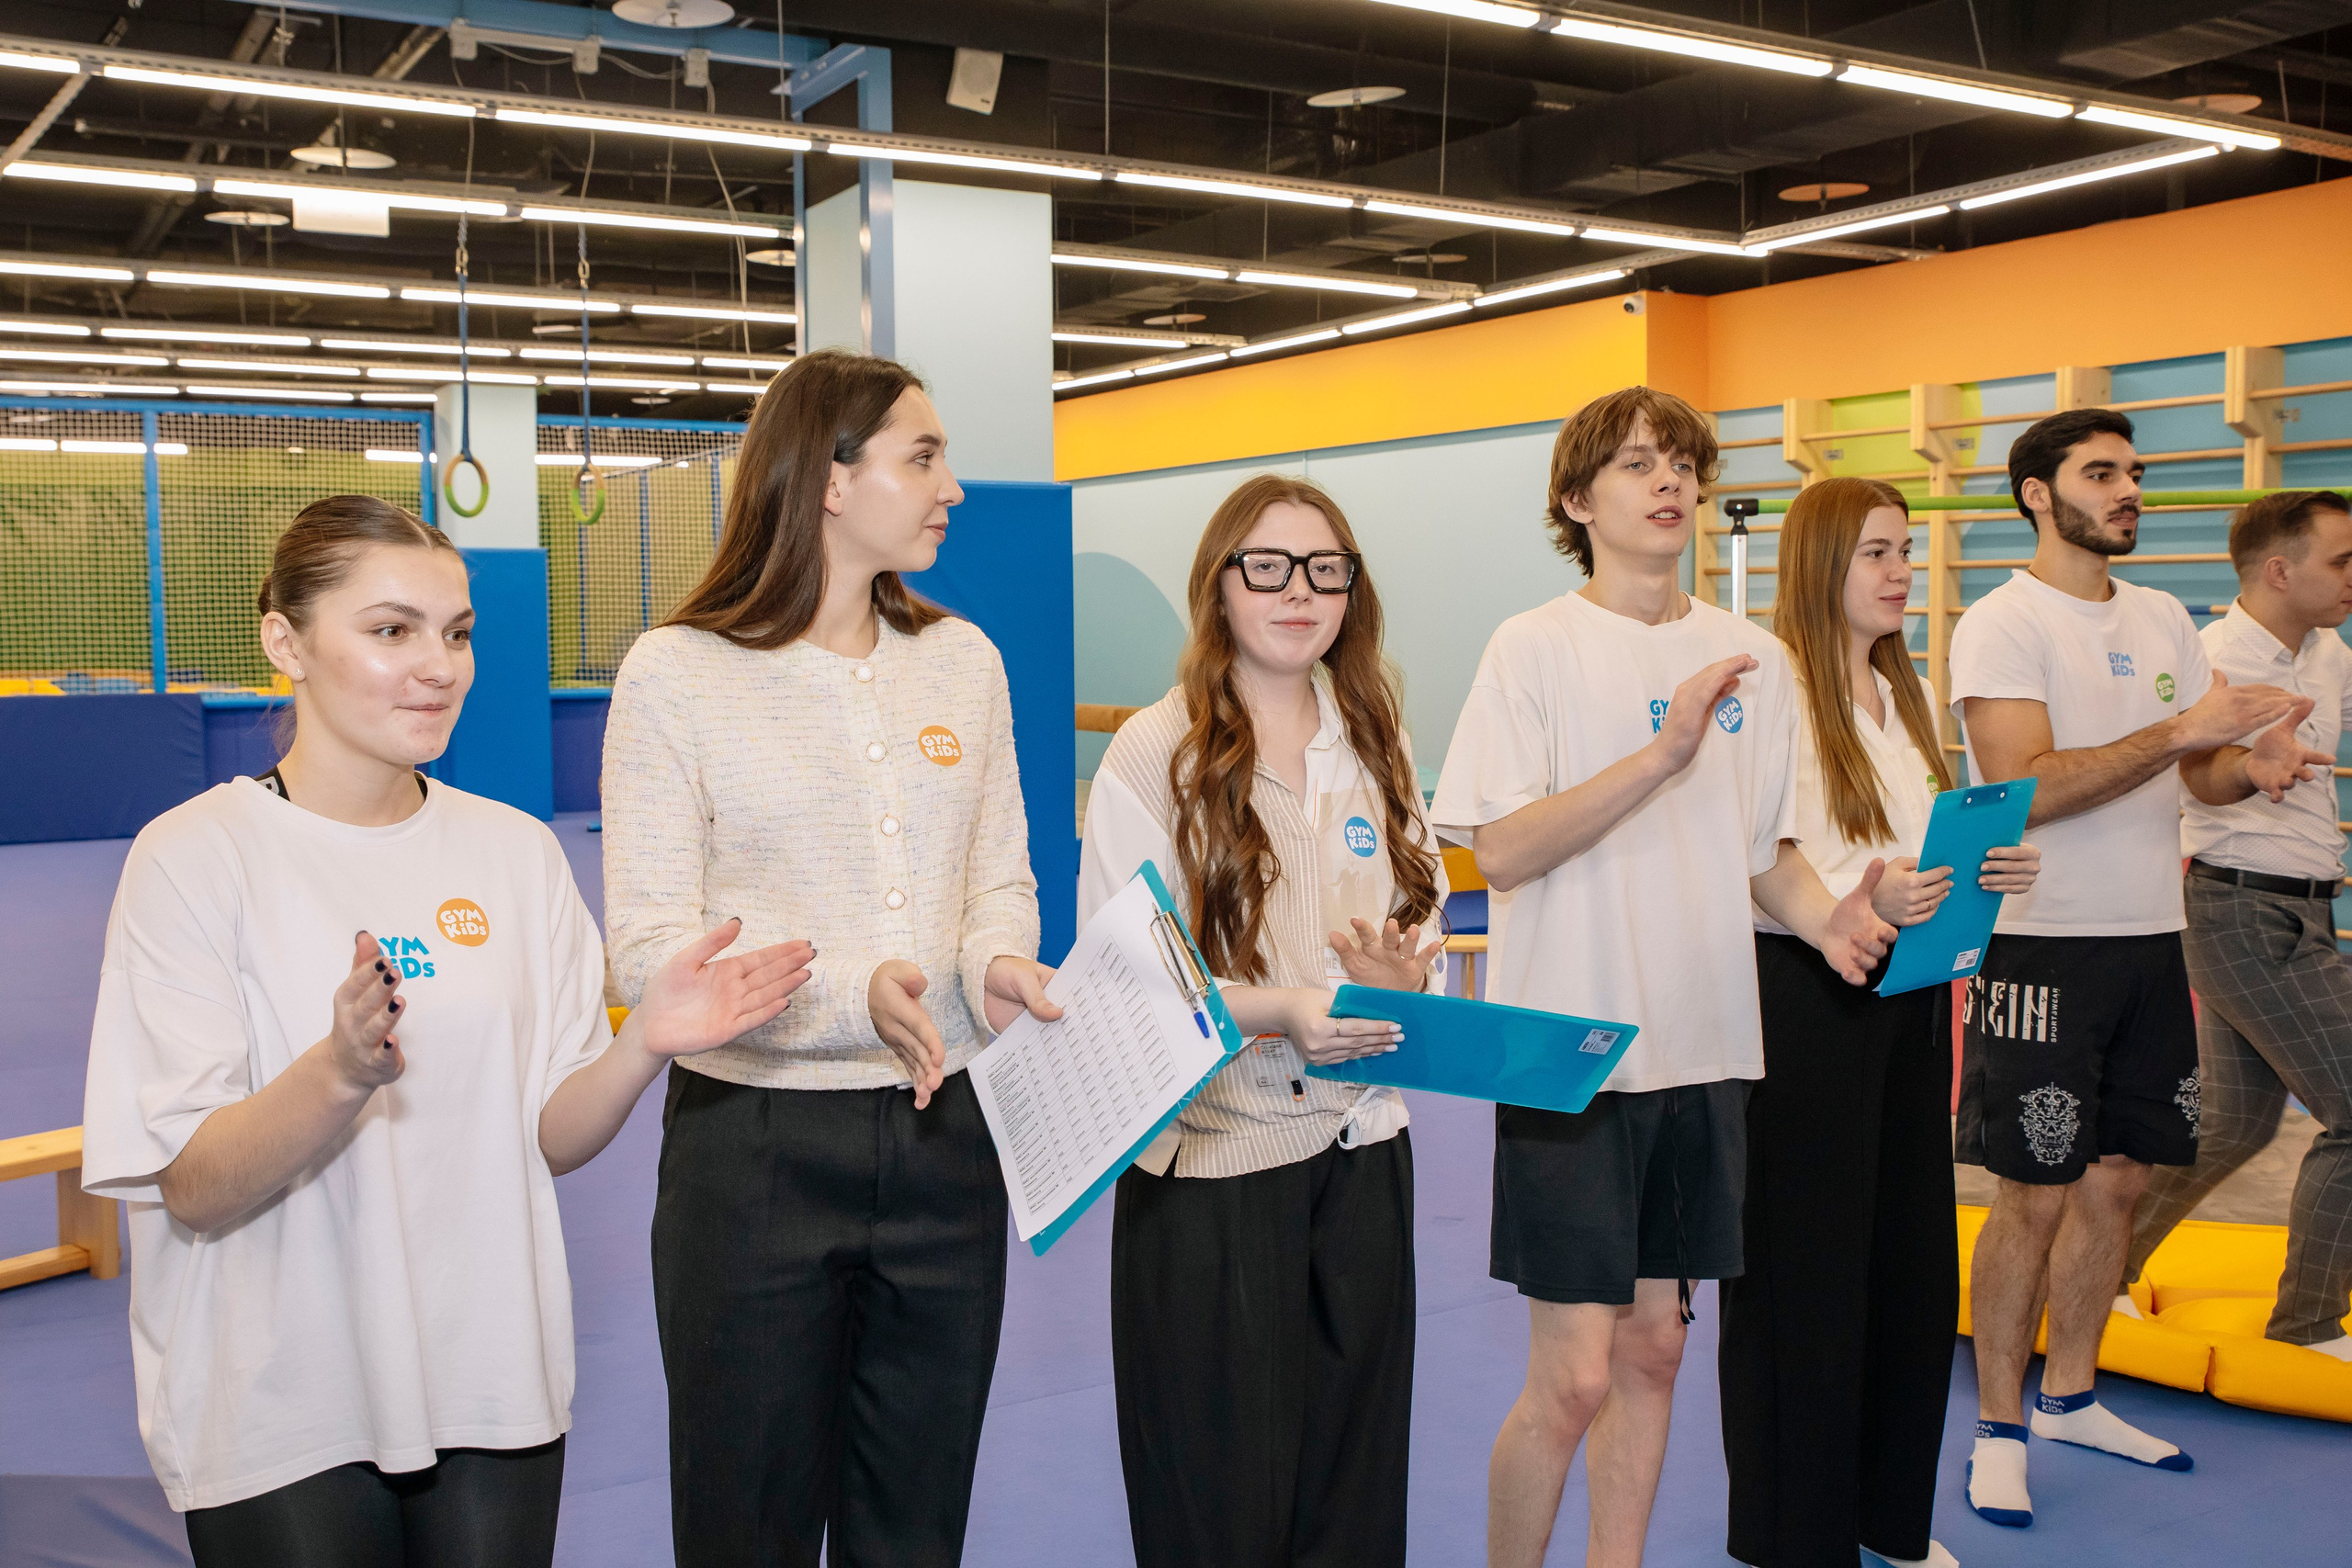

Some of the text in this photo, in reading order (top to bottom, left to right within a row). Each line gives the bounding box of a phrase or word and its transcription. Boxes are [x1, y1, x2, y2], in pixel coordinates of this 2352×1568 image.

[2108, 652, 2132, 664] GYM
[2110, 664, 2135, 676] KiDs
[1649, 699, 1669, 716] GY
[1717, 700, 1739, 722] GYM
[1723, 710, 1743, 731] KiDs
[921, 734, 956, 747] GYM
[925, 745, 960, 758] KiDs
[1346, 826, 1373, 838] GYM
[1349, 837, 1374, 850] KiDs
[440, 908, 483, 924] GYM
[445, 921, 487, 939] KiDs
[379, 936, 430, 957] YM
[2050, 987, 2061, 1043] SPORTSWEAR
[2041, 1396, 2065, 1406] GYM
[1976, 1423, 1994, 1432] YM
